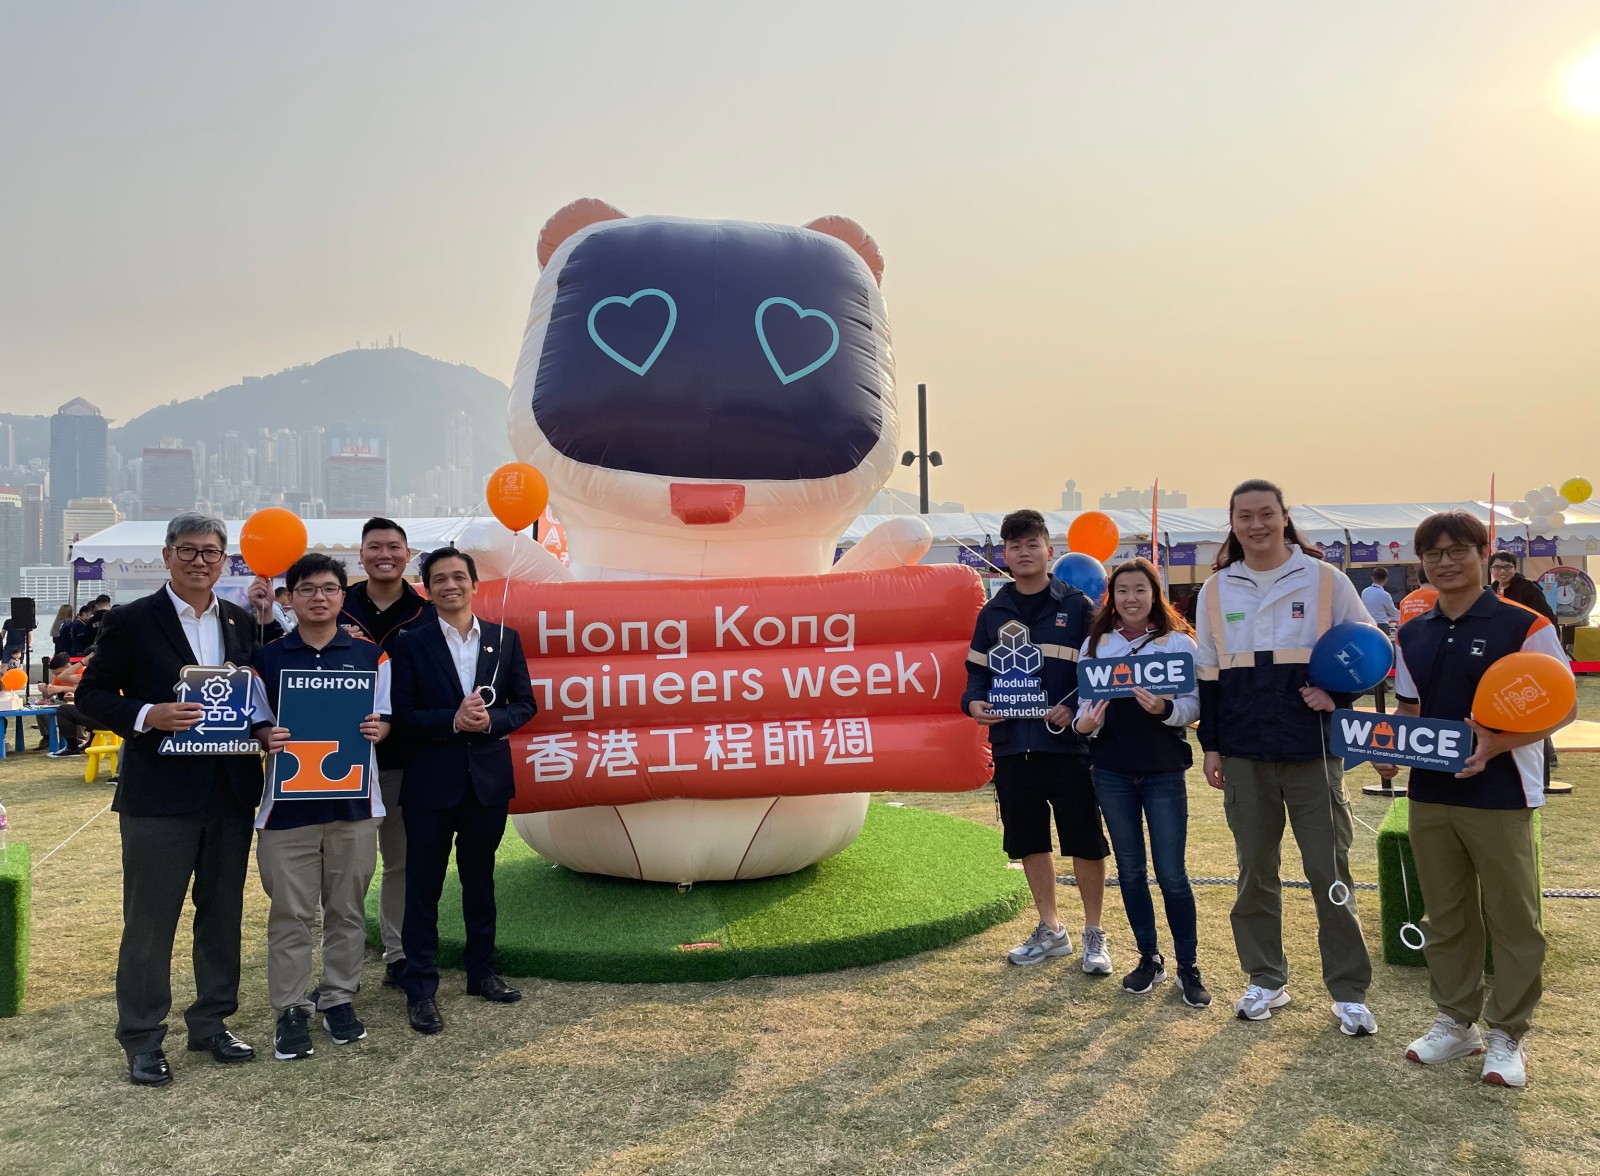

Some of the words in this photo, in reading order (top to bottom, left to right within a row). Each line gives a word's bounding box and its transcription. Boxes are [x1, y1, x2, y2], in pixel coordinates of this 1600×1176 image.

[538, 610, 687, 660] Hong
[714, 605, 856, 653] Kong
[287, 677, 370, 690] LEIGHTON
[530, 664, 764, 721] ngineers
[781, 652, 941, 700] week)
[993, 678, 1039, 688] Modular
[989, 692, 1045, 704] integrated
[161, 739, 259, 753] Automation
[525, 717, 874, 783] 香港工程師週
[1347, 746, 1366, 754] Women
[1372, 749, 1404, 759] Construction
[1416, 755, 1449, 766] Engineering
